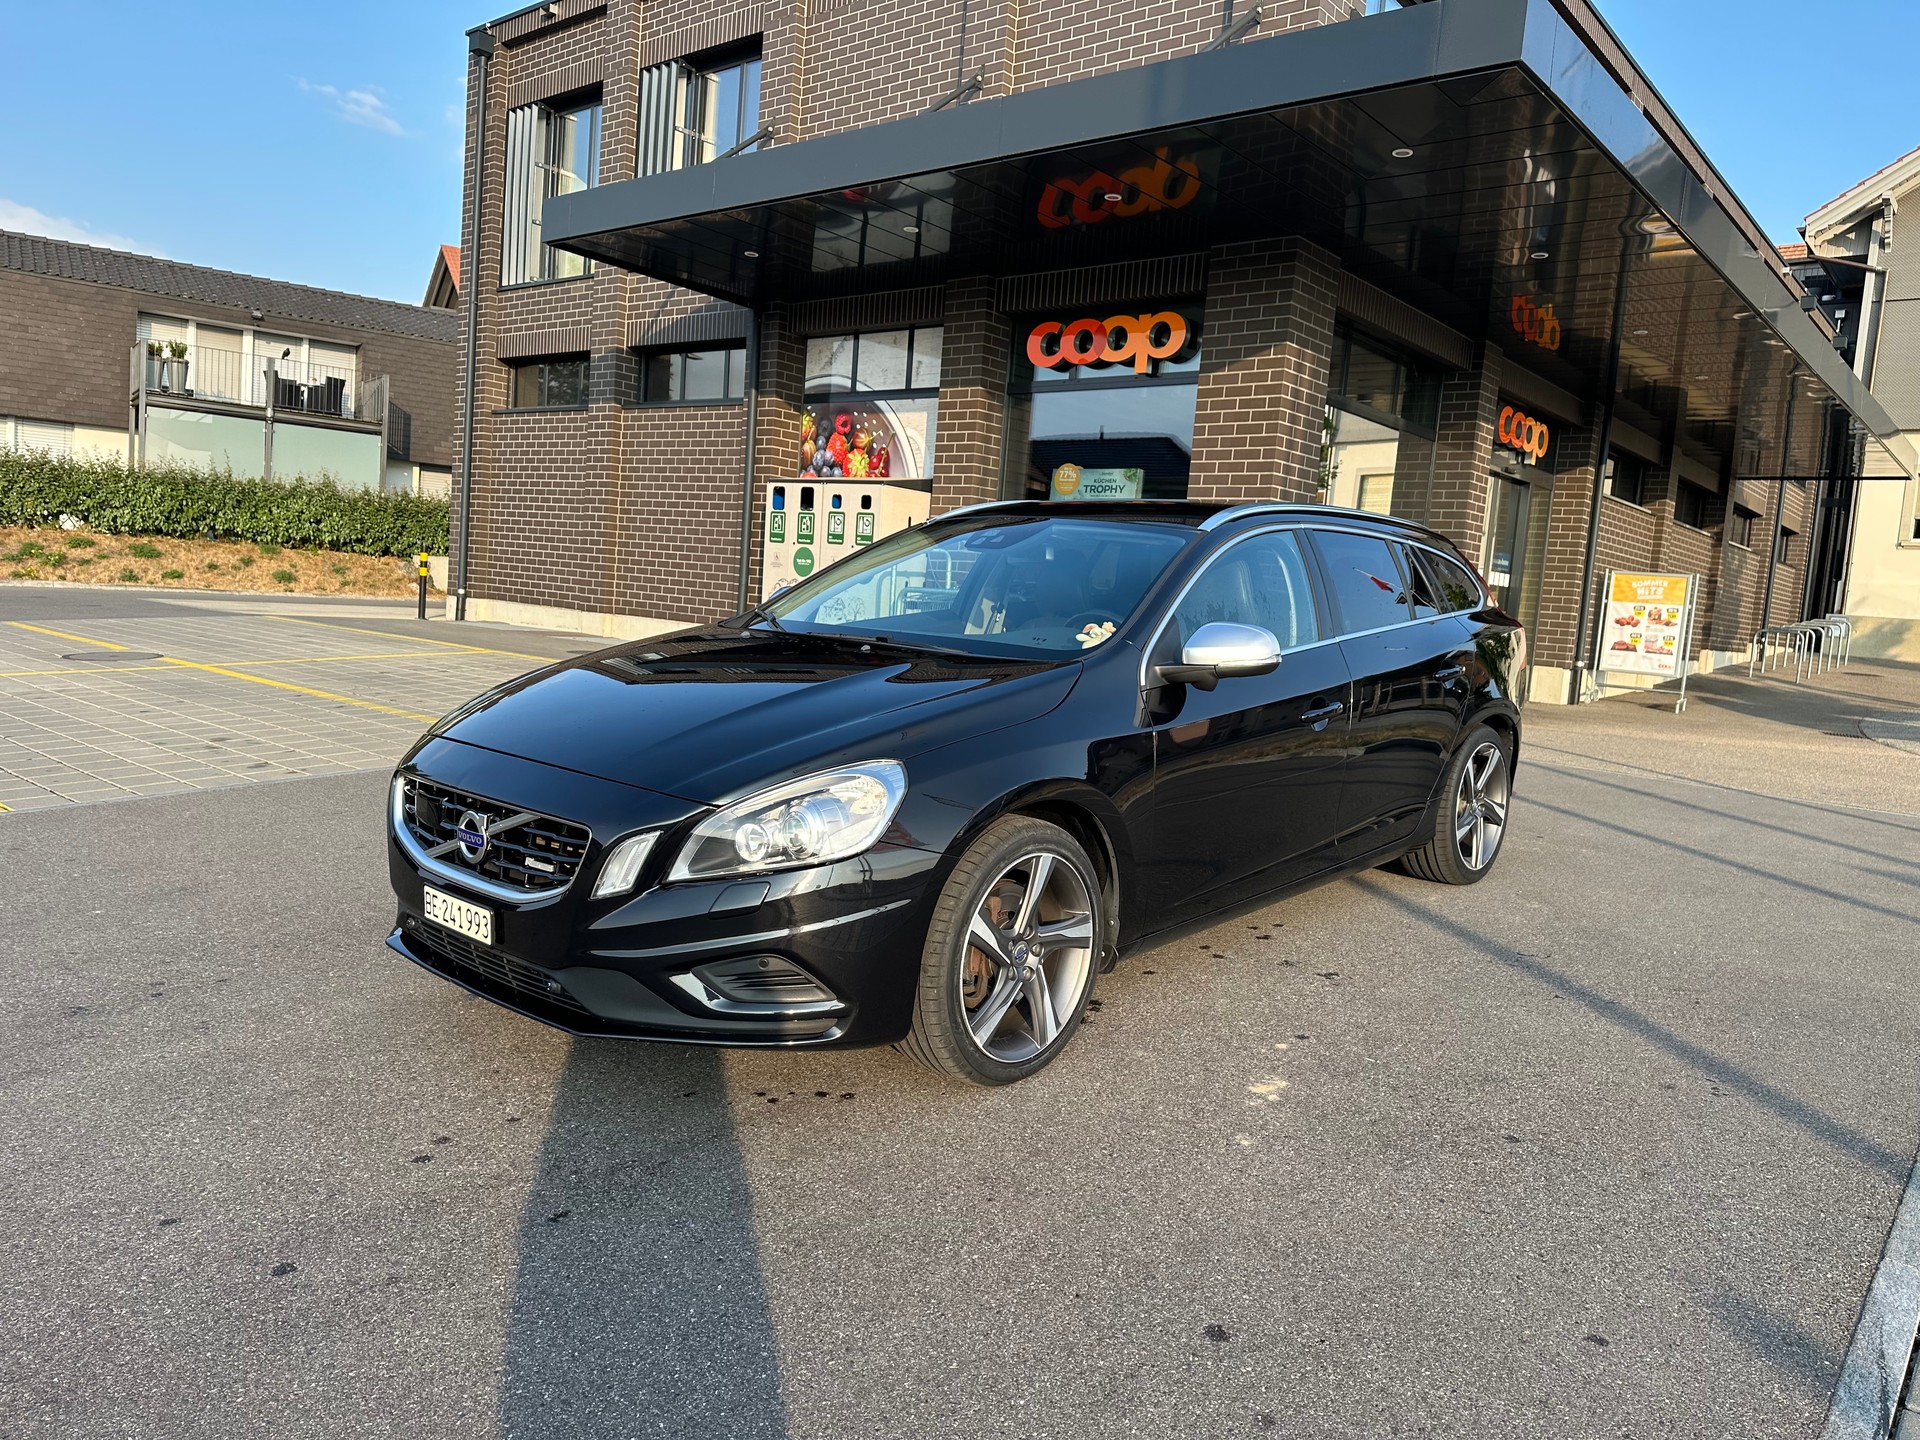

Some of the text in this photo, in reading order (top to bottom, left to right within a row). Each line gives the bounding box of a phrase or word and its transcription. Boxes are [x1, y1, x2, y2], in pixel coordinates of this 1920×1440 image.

[1026, 311, 1188, 374] coop
[1499, 405, 1549, 466] coop
[1083, 484, 1125, 493] TROPHY
[458, 830, 482, 845] VOLVO
